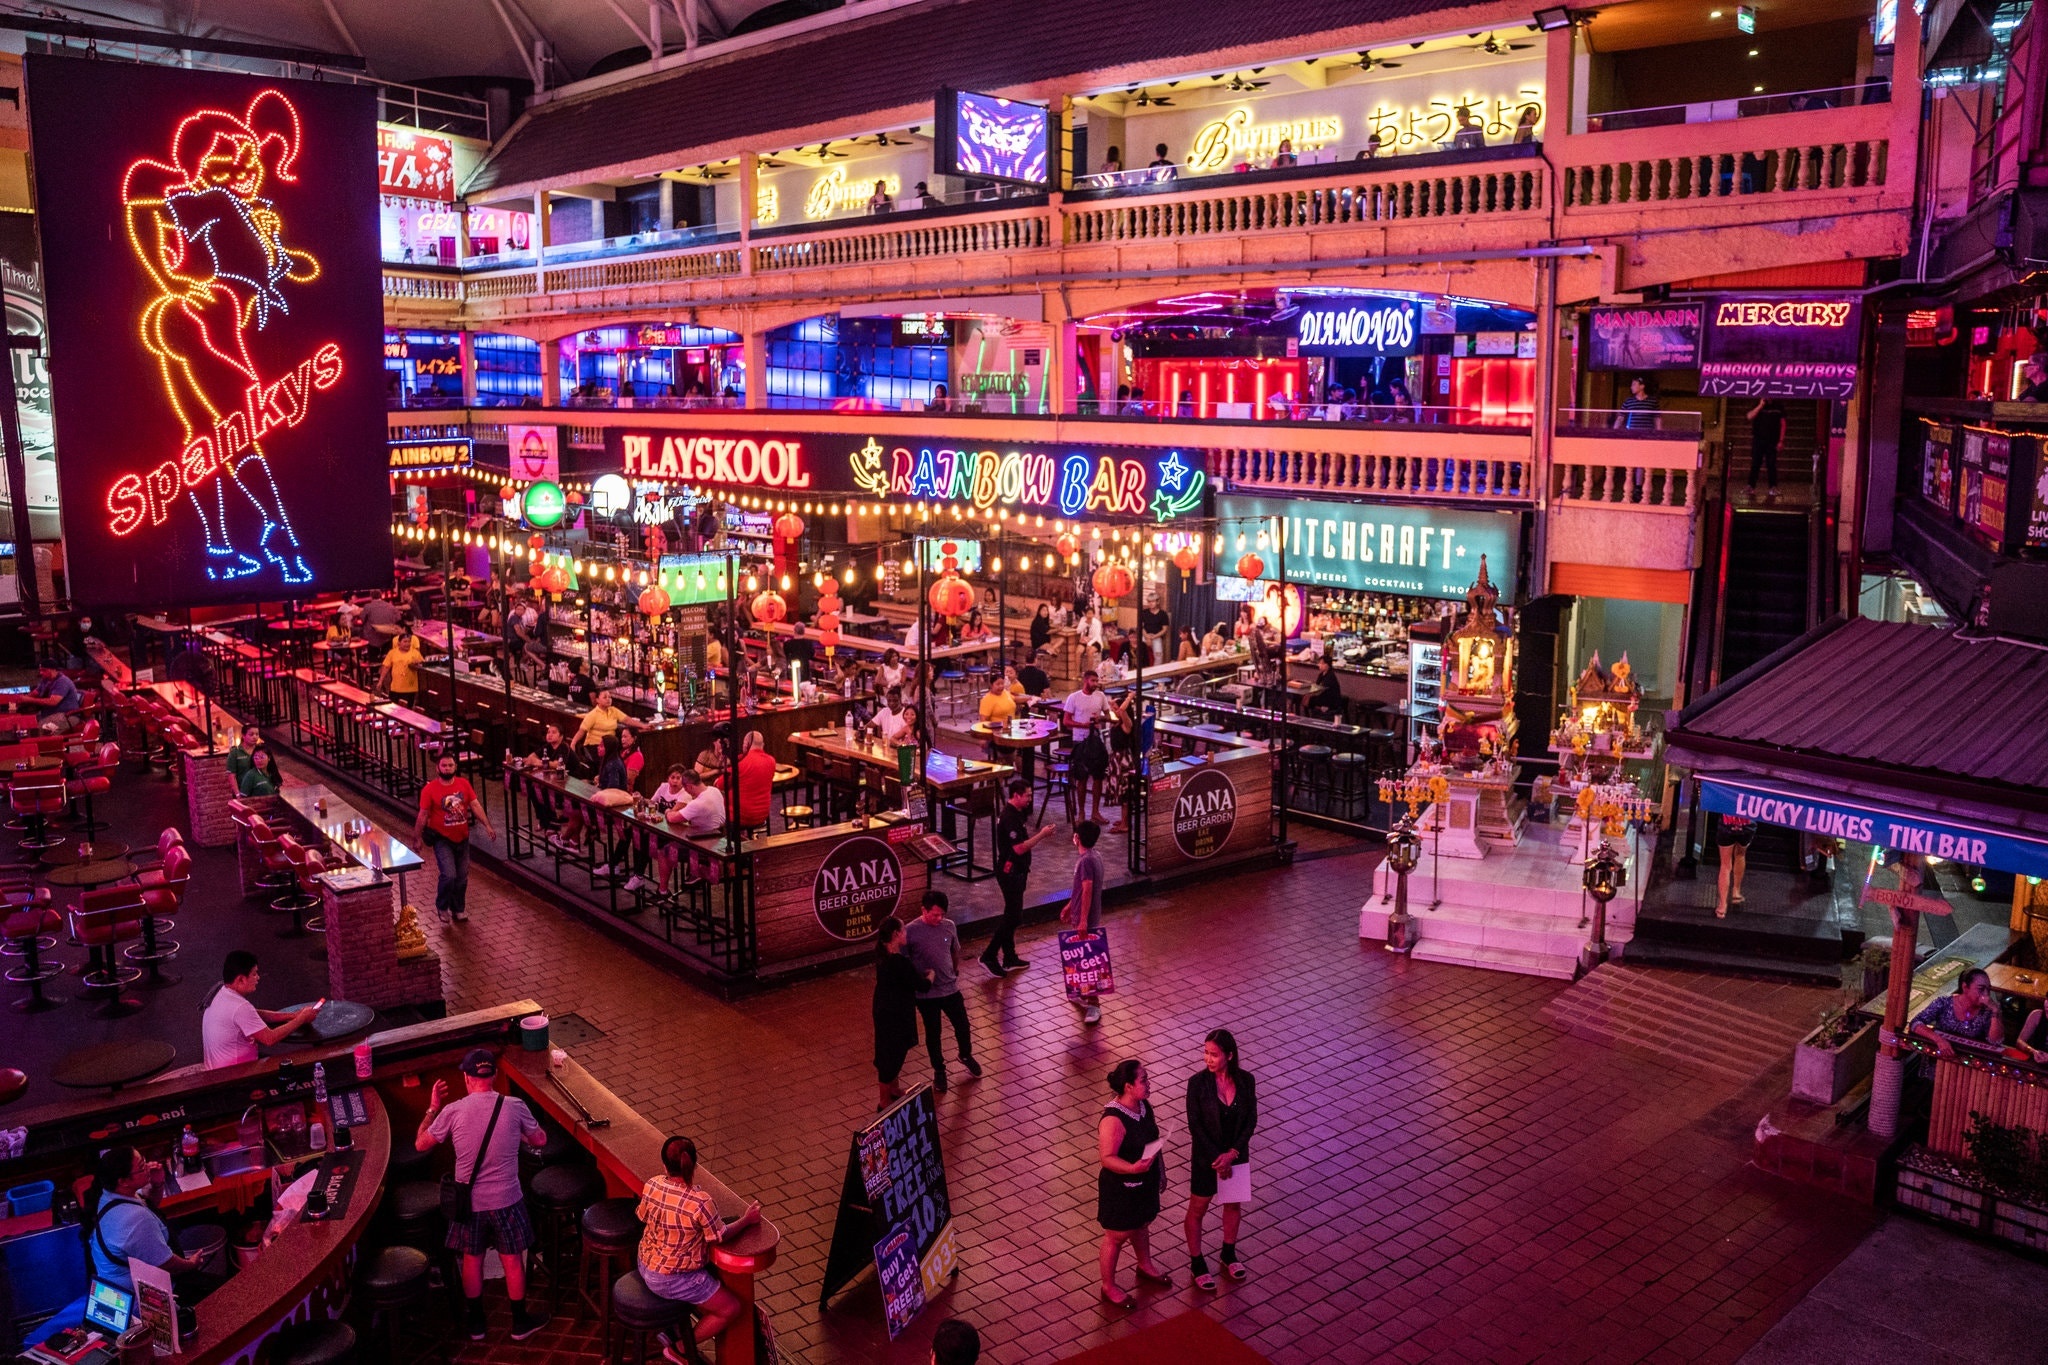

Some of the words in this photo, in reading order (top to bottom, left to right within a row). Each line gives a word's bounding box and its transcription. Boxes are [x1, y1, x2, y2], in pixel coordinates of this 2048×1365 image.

[1595, 309, 1699, 330] MANDARIN
[1716, 302, 1851, 326] MERCURY
[1299, 308, 1414, 351] DIAMONDS
[1701, 363, 1772, 378] BANGKOK
[1775, 363, 1857, 378] LADYBOYS
[1701, 378, 1766, 396] バンコク
[1768, 381, 1854, 397] ニューハーフ
[107, 343, 343, 536] Spankys
[389, 446, 457, 466] AINBOW
[458, 445, 469, 461] 2
[622, 435, 810, 488] PLAYSKOOL
[1059, 455, 1146, 515] BAR
[1270, 516, 1456, 569] WITCHCRAFT
[1286, 569, 1311, 580] RAFT
[1316, 572, 1347, 583] BEERS
[1364, 577, 1423, 591] COCKTAILS
[1179, 788, 1234, 818] NANA
[1176, 820, 1198, 833] BEER
[1200, 812, 1233, 827] GARDEN
[1735, 793, 1804, 829] LUCKY
[1805, 807, 1874, 842] LUKES
[1888, 823, 1934, 855] TIKI
[1937, 833, 1988, 865] BAR
[821, 858, 898, 894] NANA
[819, 894, 849, 911] BEER
[851, 884, 897, 904] GARDEN
[849, 904, 865, 915] EAT
[846, 914, 872, 927] DRINK
[846, 924, 873, 938] RELAX
[1062, 946, 1084, 961] Buy
[1084, 942, 1093, 953] 1
[1081, 955, 1102, 970] Get
[1101, 951, 1109, 962] 1
[1065, 970, 1099, 985] FREE!
[883, 1103, 911, 1148] BUY
[887, 1132, 919, 1180] GET
[918, 1126, 933, 1158] 1
[883, 1162, 927, 1223] FREE
[911, 1194, 936, 1249] 10
[881, 1256, 899, 1286] Buy
[897, 1247, 905, 1261] 1
[897, 1262, 914, 1289] Get
[911, 1254, 918, 1267] 1
[888, 1285, 914, 1319] FREE!
